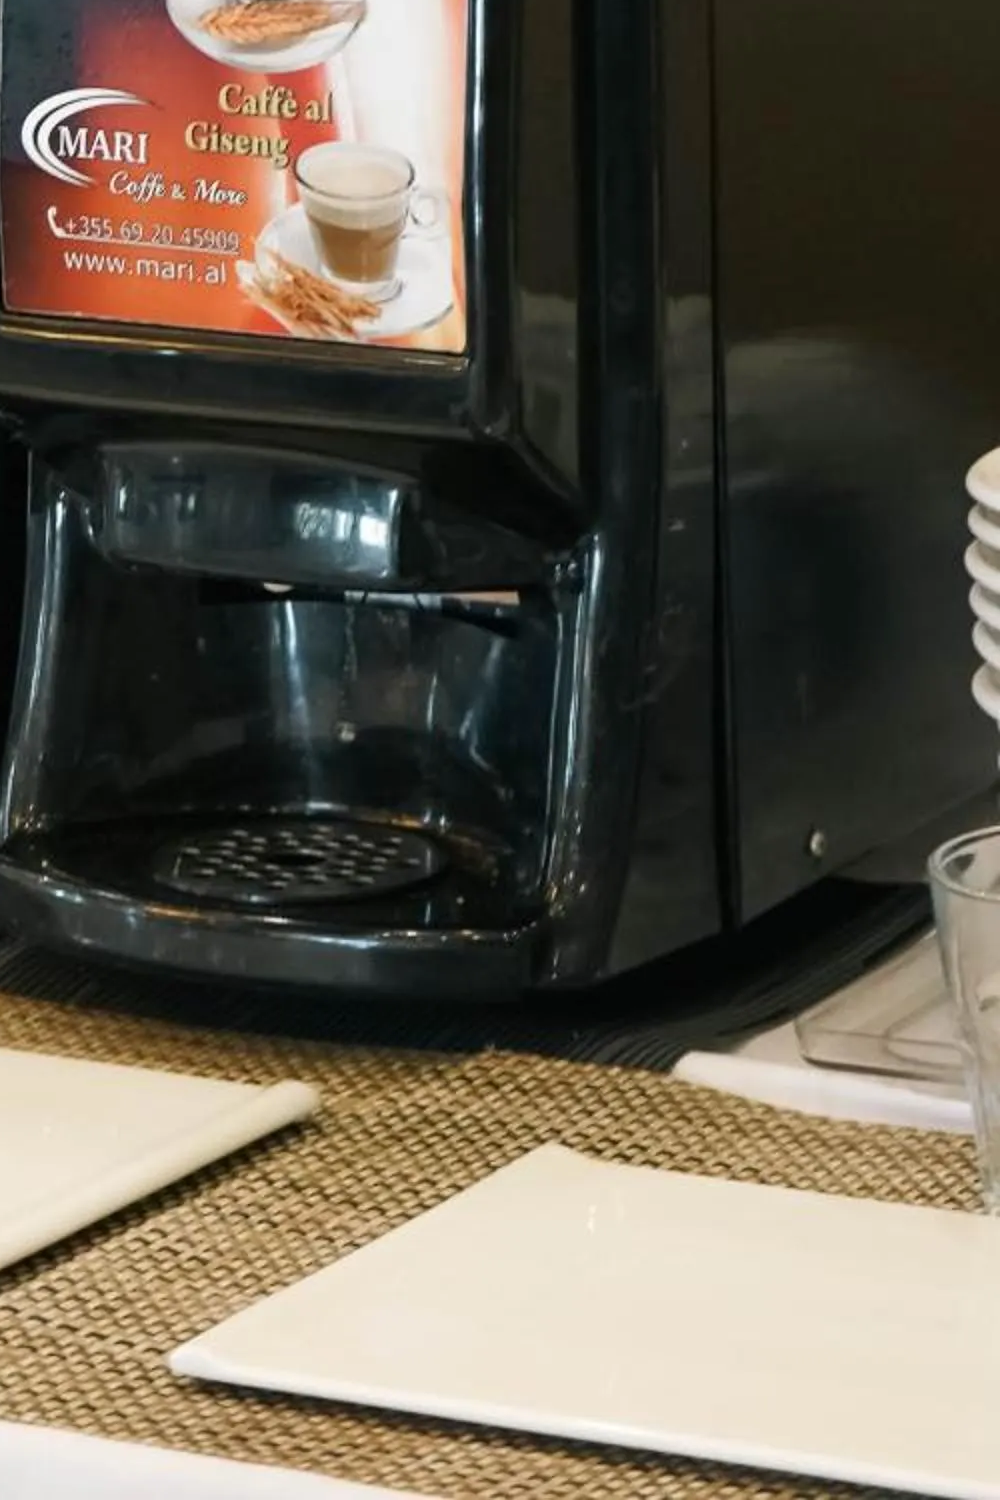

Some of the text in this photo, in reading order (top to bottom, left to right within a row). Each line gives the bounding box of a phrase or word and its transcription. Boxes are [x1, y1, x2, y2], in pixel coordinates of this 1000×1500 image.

[218, 83, 333, 125] Caffè al
[57, 126, 149, 165] MARI
[184, 121, 291, 170] Giseng
[170, 183, 187, 201] &
[193, 178, 248, 206] More
[65, 215, 240, 252] +355 69 20 45909
[63, 250, 227, 285] www.mari.al
